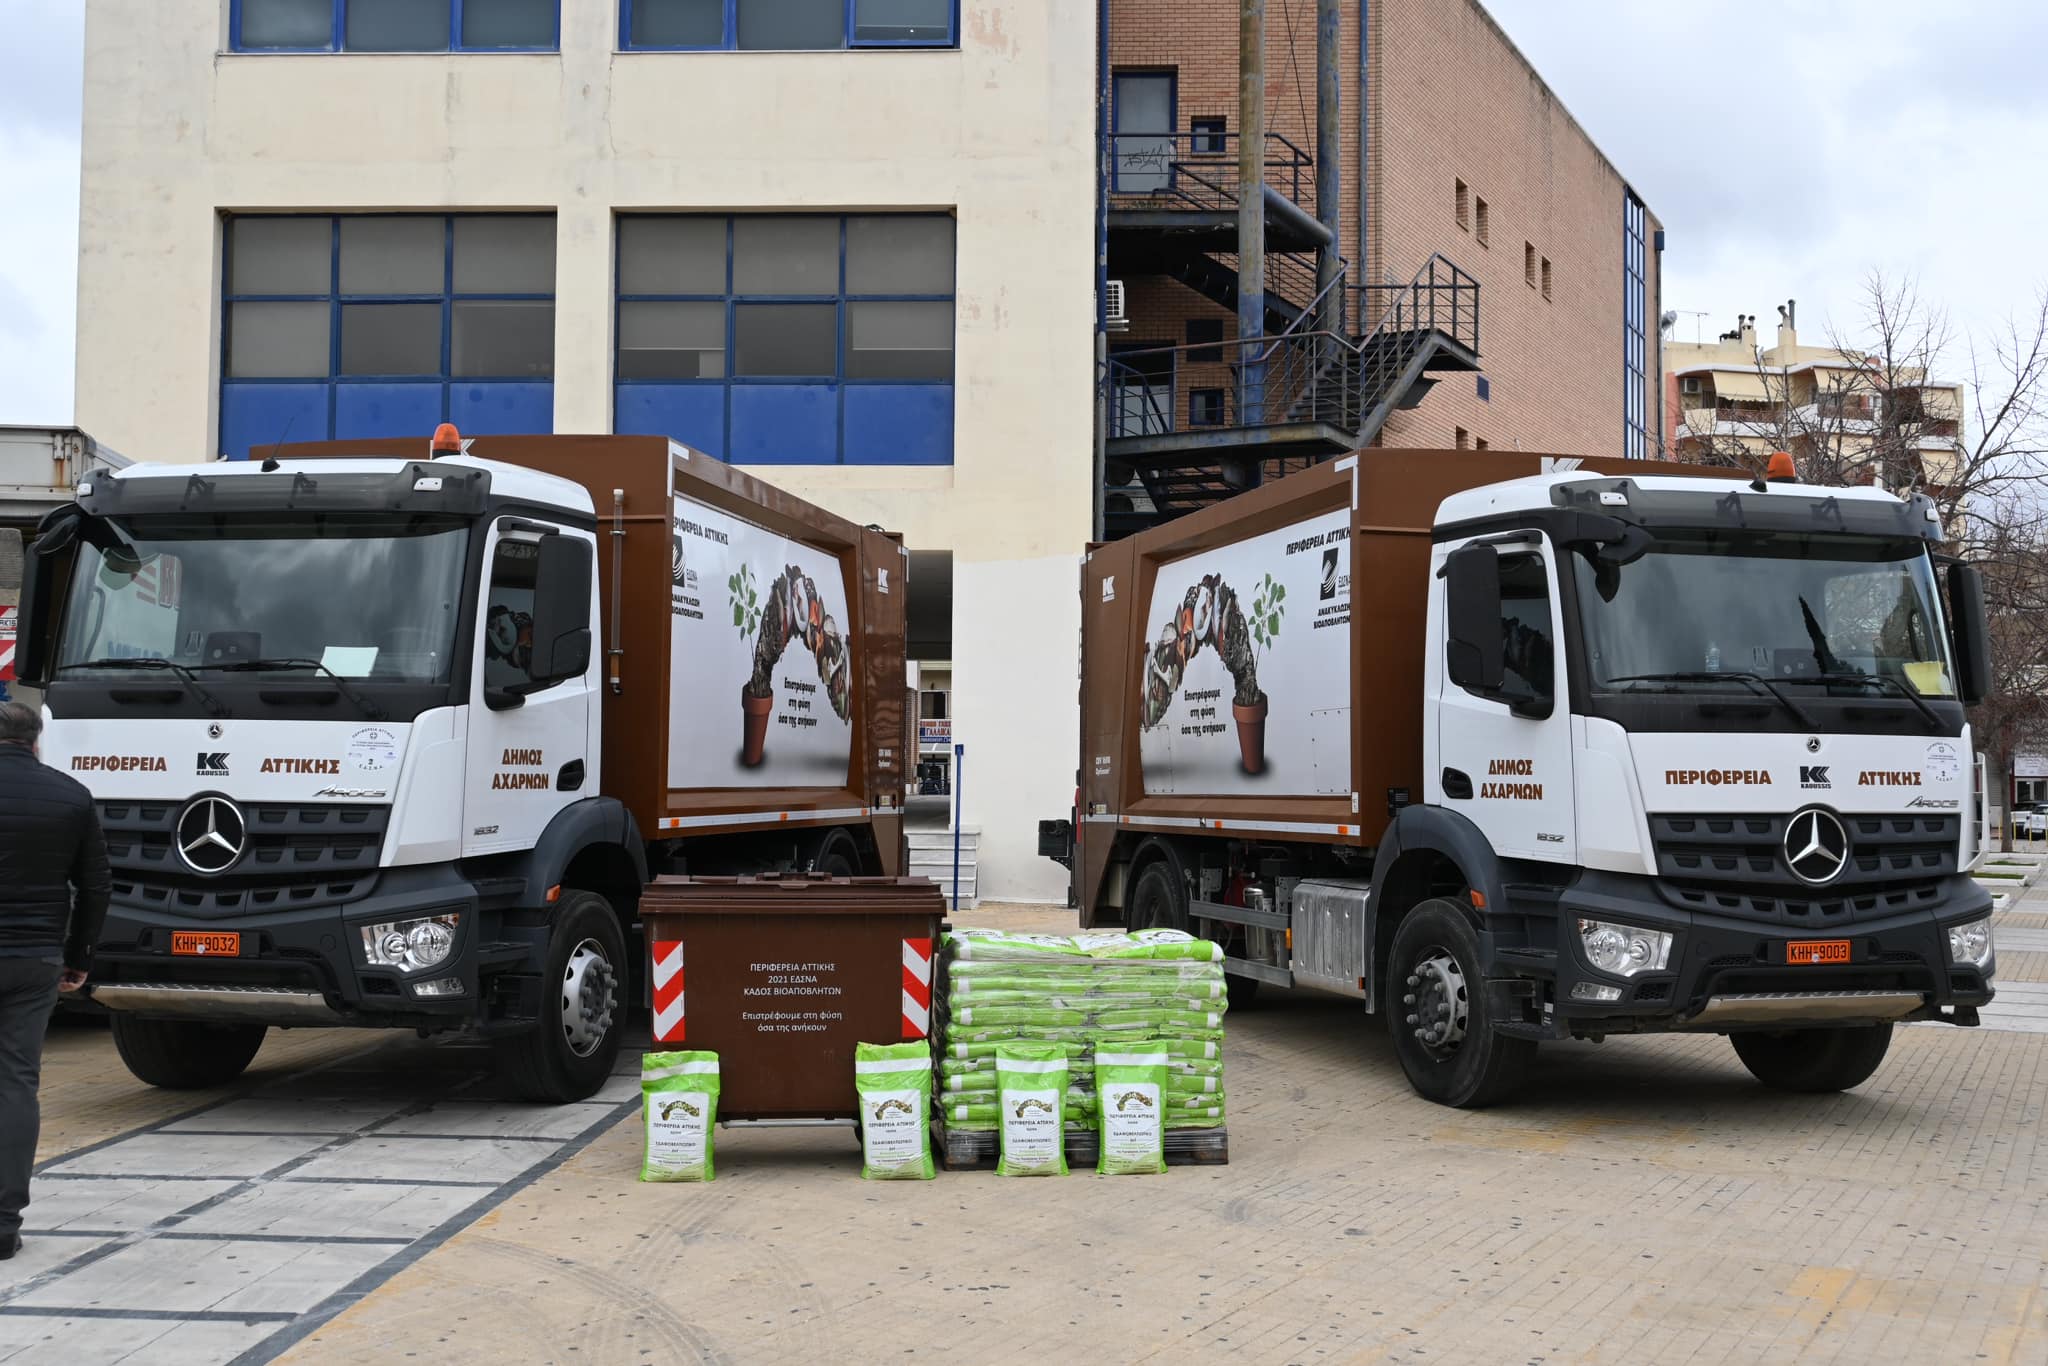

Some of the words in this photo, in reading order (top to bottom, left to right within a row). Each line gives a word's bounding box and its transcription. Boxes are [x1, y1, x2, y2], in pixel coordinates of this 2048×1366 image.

[1286, 534, 1324, 556] ΠΕΡΙΦΕΡΕΙΑ
[71, 755, 168, 772] ΠΕΡΙΦΕΡΕΙΑ
[502, 749, 543, 766] ΔΗΜΟΣ
[260, 758, 340, 774] ΑΤΤΙΚΗΣ
[1488, 759, 1533, 776] ΔΗΜΟΣ
[492, 773, 549, 790] ΑΧΑΡΝΩΝ
[1665, 769, 1772, 785] ΠΕΡΙΦΕΡΕΙΑ
[1858, 771, 1922, 786] ΑΤΤΙΚΗΣ
[1480, 783, 1543, 800] ΑΧΑΡΝΩΝ
[750, 963, 800, 972] ΠΕΡΙΦΕΡΕΙΑ
[801, 963, 836, 972] ΑΤΤΙΚΗΣ
[768, 975, 788, 983] 2021
[790, 975, 818, 983] ΕΔΣΝΑ
[743, 987, 772, 996] ΚΑΔΟΣ
[774, 987, 842, 995] ΒΙΟΑΠΟΒΛΗΤΩΝ
[742, 1011, 801, 1021] Επιστρέφουμε
[803, 1012, 818, 1021] στη
[820, 1010, 842, 1021] φύση
[757, 1023, 774, 1032] όσα
[776, 1024, 790, 1033] της
[791, 1022, 827, 1033] ανήκουν
